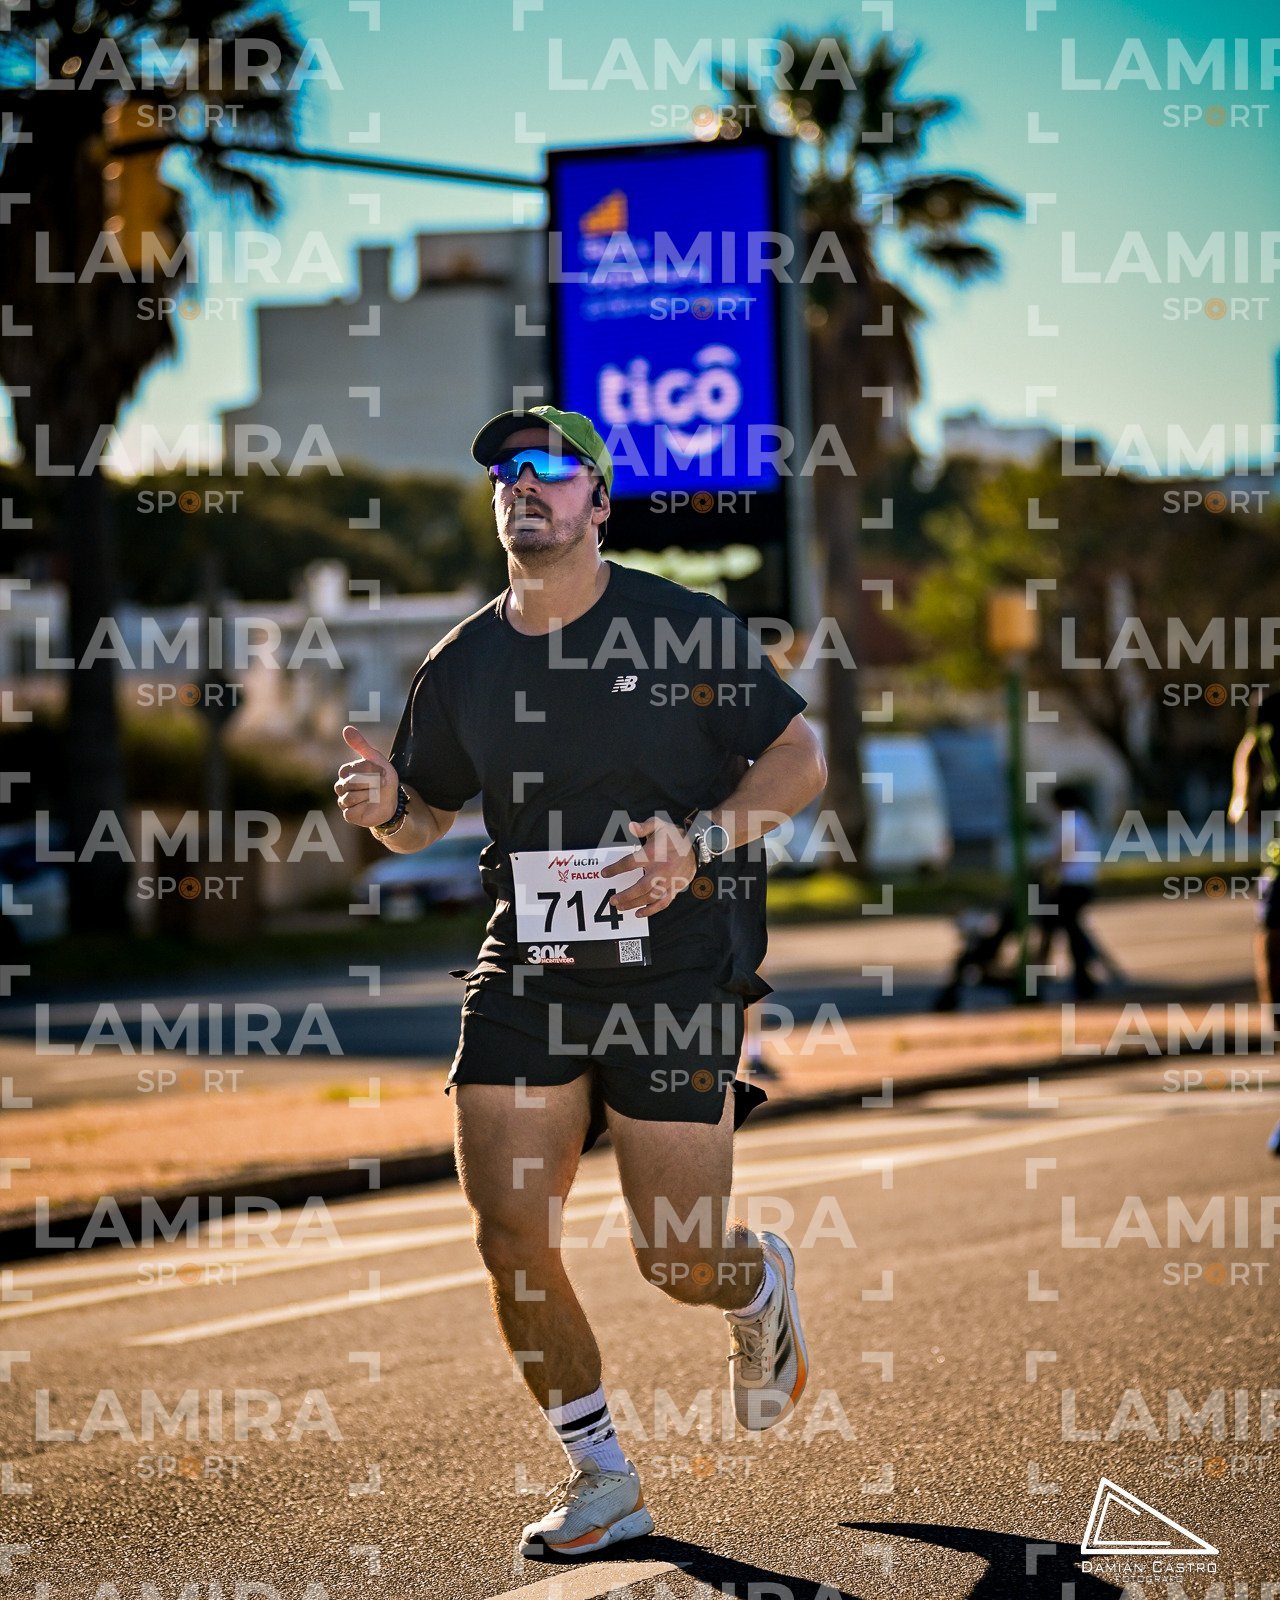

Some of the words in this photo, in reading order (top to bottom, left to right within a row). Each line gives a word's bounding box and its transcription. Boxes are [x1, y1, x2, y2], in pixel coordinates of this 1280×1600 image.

[573, 858, 599, 867] ucm
[571, 871, 600, 880] FALCK
[537, 888, 624, 933] 714
[527, 944, 570, 964] 30K
